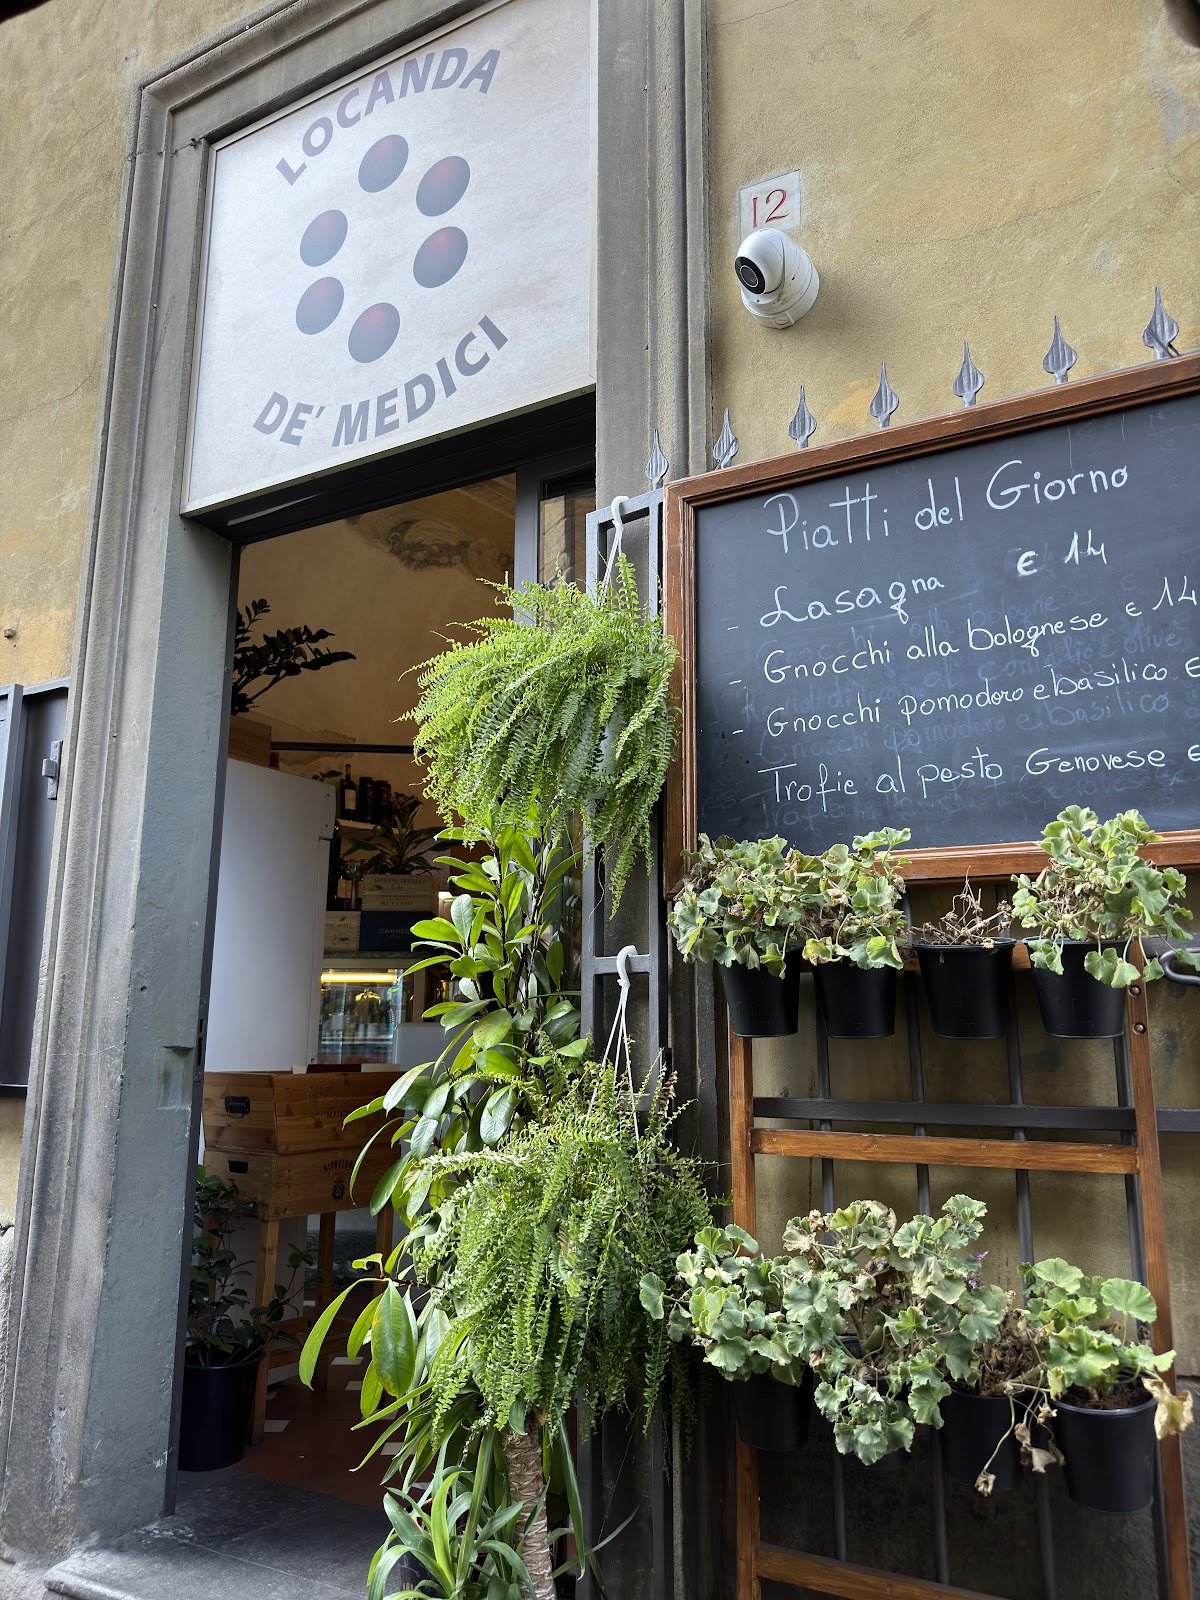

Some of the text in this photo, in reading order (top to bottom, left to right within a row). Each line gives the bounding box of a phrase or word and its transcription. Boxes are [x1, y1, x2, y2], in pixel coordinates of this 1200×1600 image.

[275, 47, 501, 187] LOCANDA
[752, 188, 790, 228] 12
[331, 314, 509, 447] MEDICI
[763, 460, 1129, 554] Piatti del Giorno
[759, 577, 945, 627] Lasagna
[1016, 550, 1039, 576] €
[1064, 530, 1107, 565] 14
[764, 640, 891, 684] Gnocchi
[906, 625, 960, 660] alla
[967, 613, 1108, 657] bolognese
[1152, 575, 1198, 610] 14
[767, 692, 881, 737] Gnocchi
[898, 678, 1024, 725] pomodoro
[757, 763, 858, 812] Trofie
[875, 755, 906, 793] al
[916, 746, 1003, 799] pesto
[1025, 747, 1166, 775] Genovese
